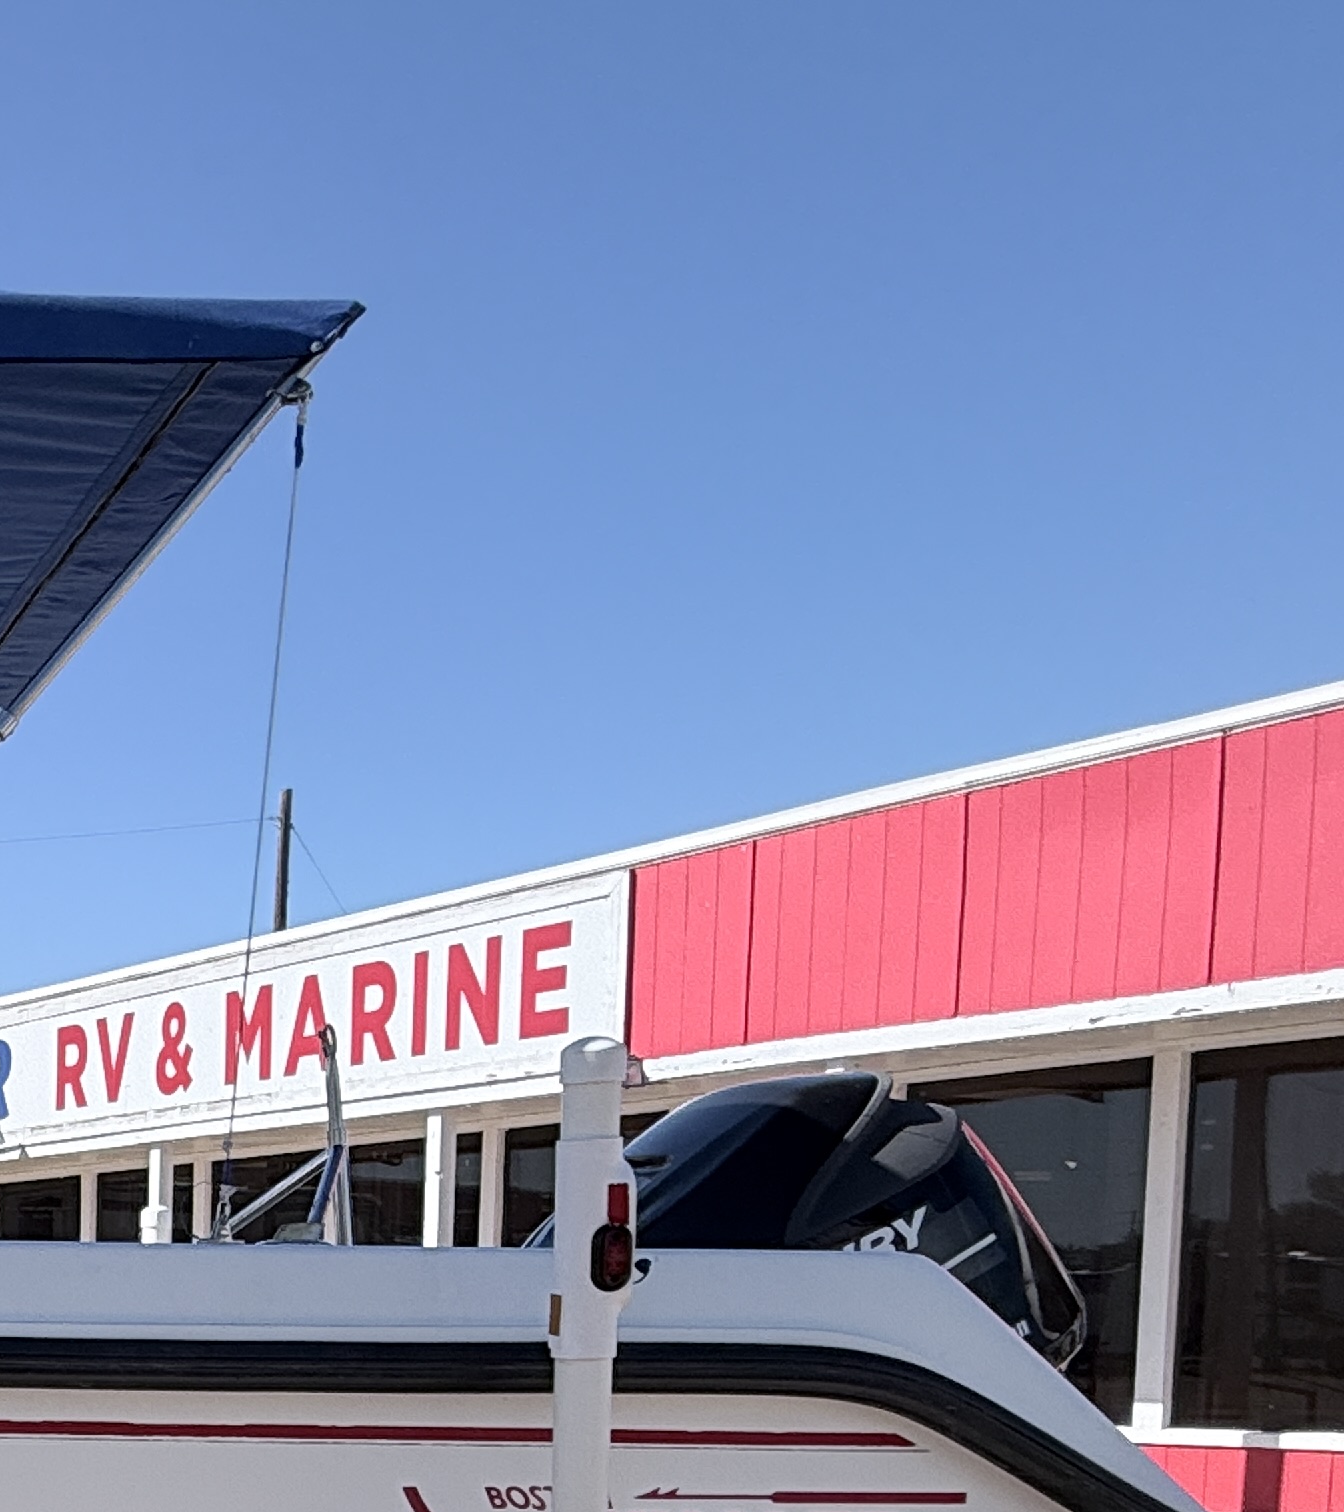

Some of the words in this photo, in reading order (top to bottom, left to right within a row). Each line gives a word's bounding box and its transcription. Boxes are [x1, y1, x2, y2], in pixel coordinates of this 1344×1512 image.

[55, 1012, 134, 1110] RV
[156, 1002, 193, 1095] &
[225, 920, 572, 1085] MARINE
